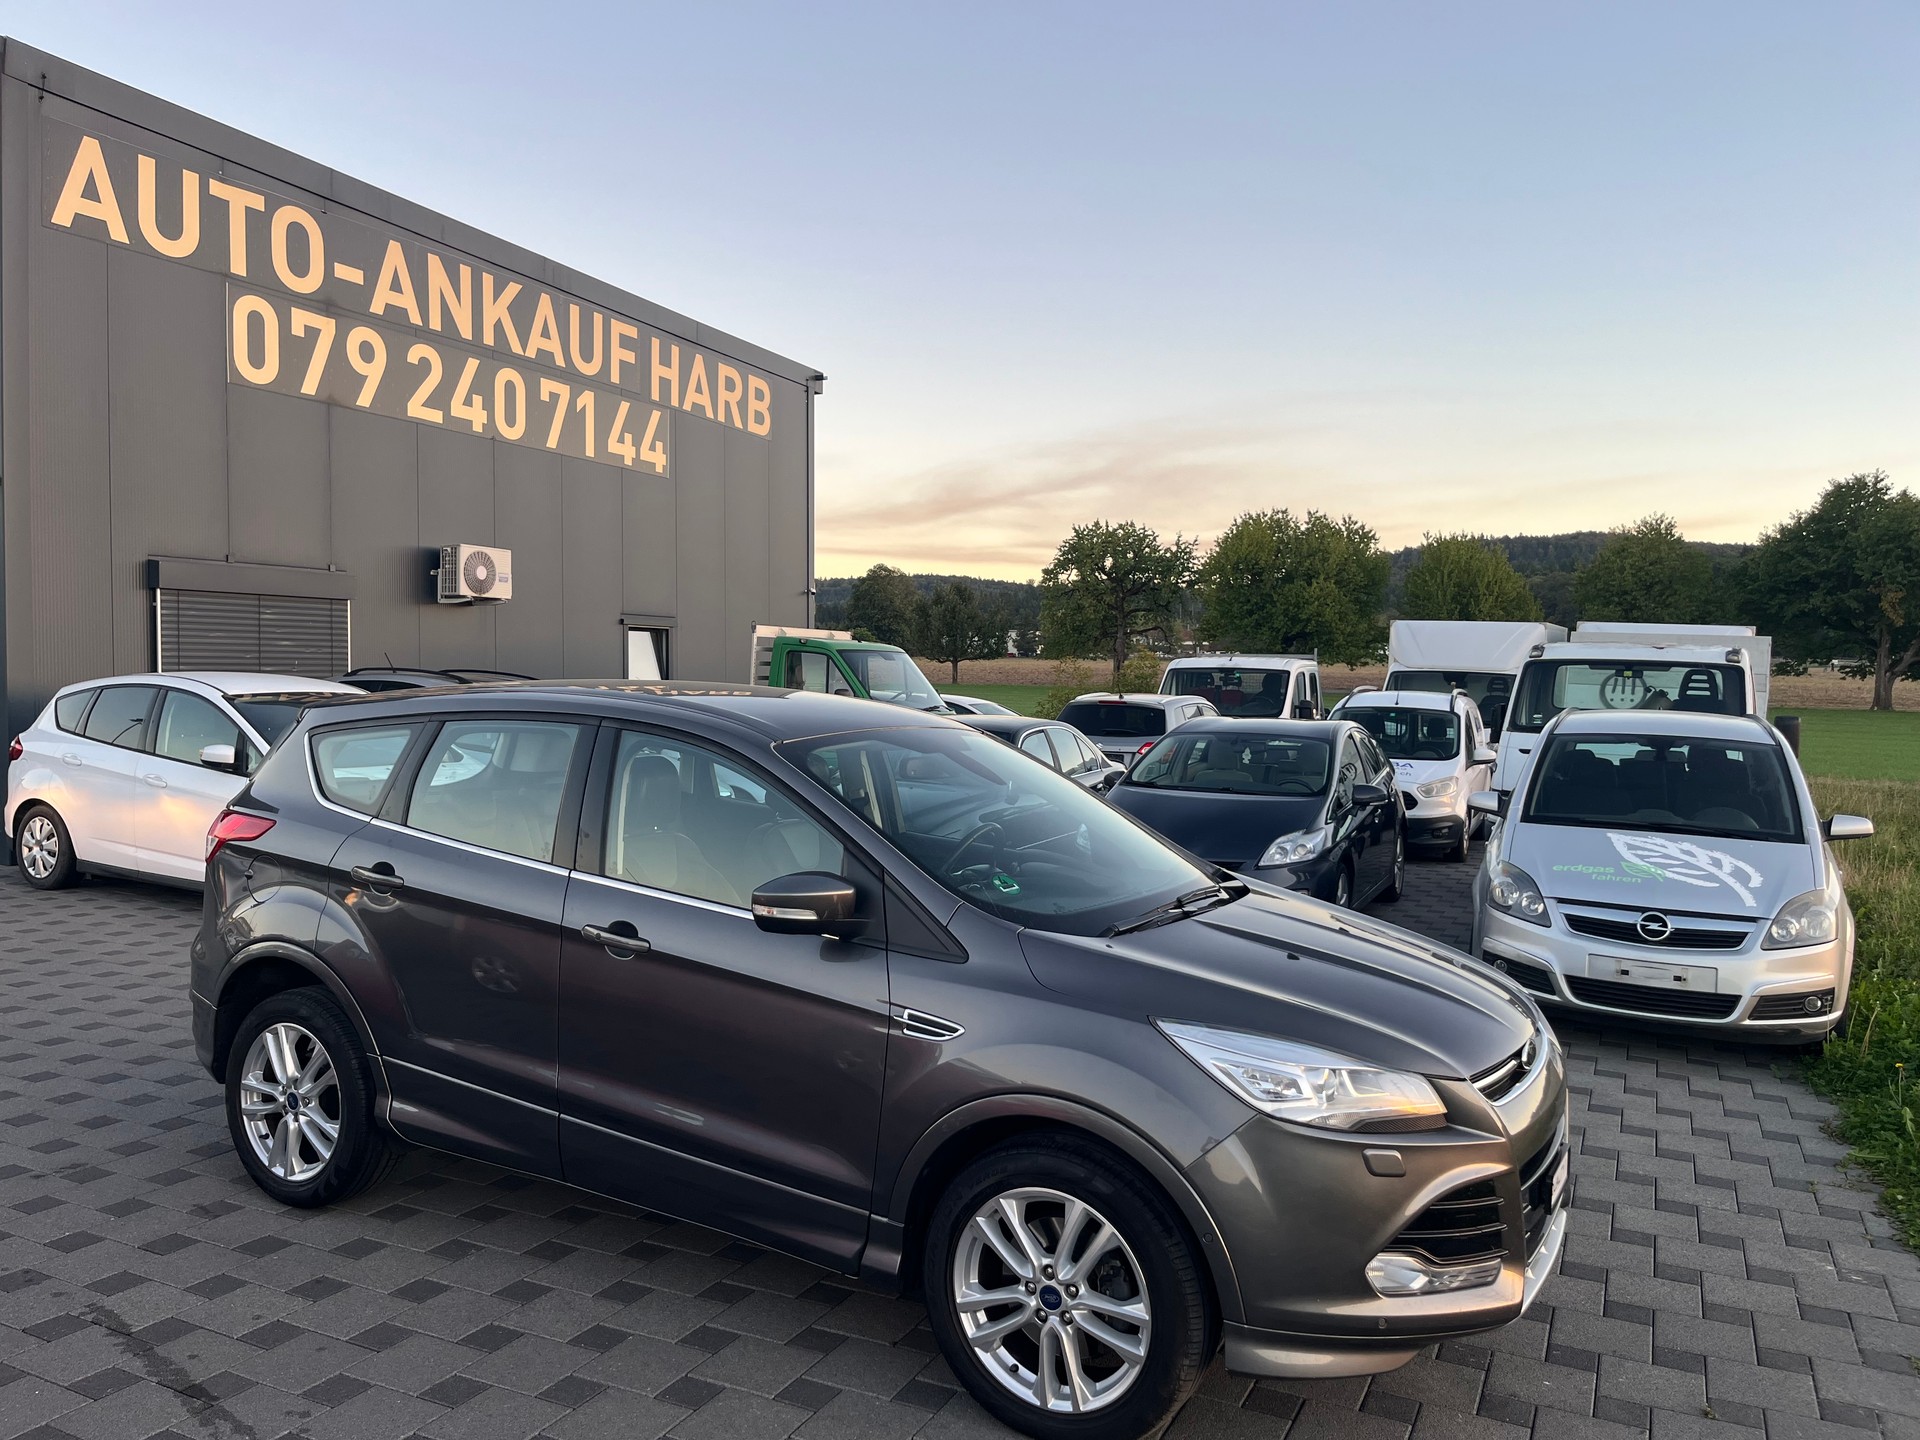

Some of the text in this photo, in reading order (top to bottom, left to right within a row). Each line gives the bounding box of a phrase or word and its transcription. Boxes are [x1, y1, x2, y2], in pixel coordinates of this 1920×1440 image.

[51, 135, 771, 437] AUTO-ANKAUF HARB
[232, 295, 387, 408] 079
[407, 343, 526, 442] 240
[1552, 864, 1616, 874] erdgas
[1591, 873, 1641, 883] fahren
